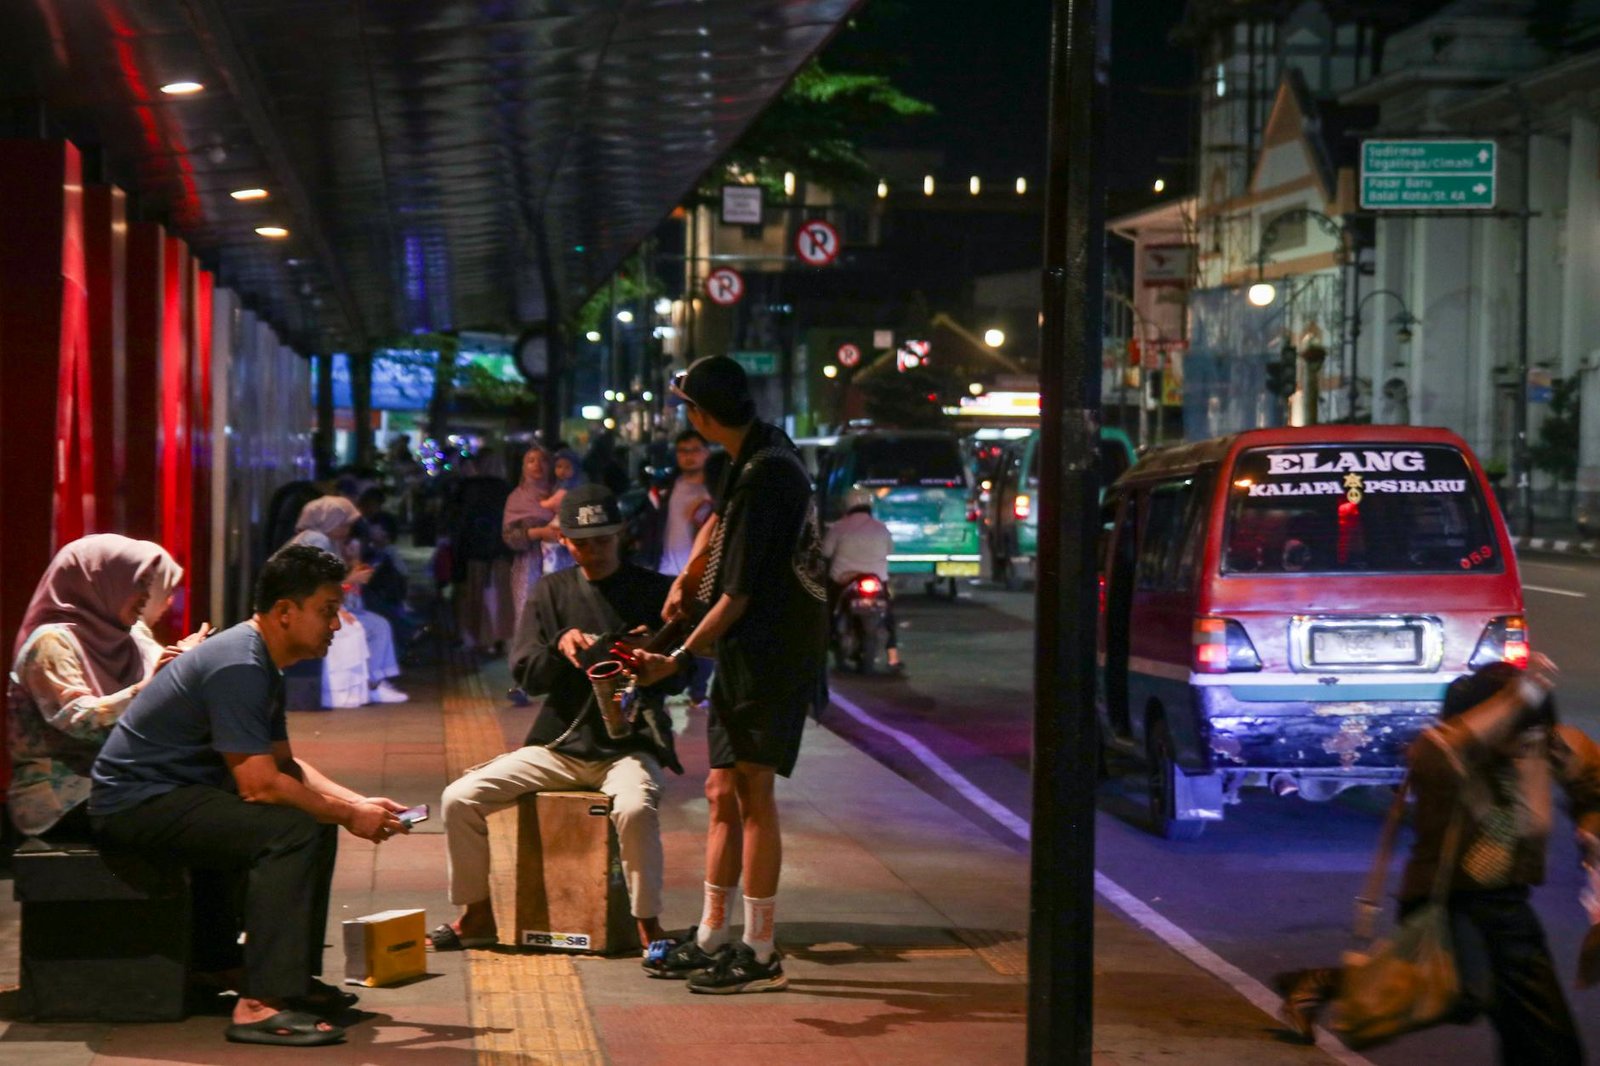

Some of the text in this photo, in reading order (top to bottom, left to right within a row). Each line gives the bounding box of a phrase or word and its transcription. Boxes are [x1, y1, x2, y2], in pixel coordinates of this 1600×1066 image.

[1369, 146, 1425, 157] Sudirman
[1370, 178, 1432, 188] Pasar Baru
[1369, 191, 1398, 201] Balai
[1267, 451, 1426, 475] ELANG
[1248, 481, 1344, 497] KALAPA
